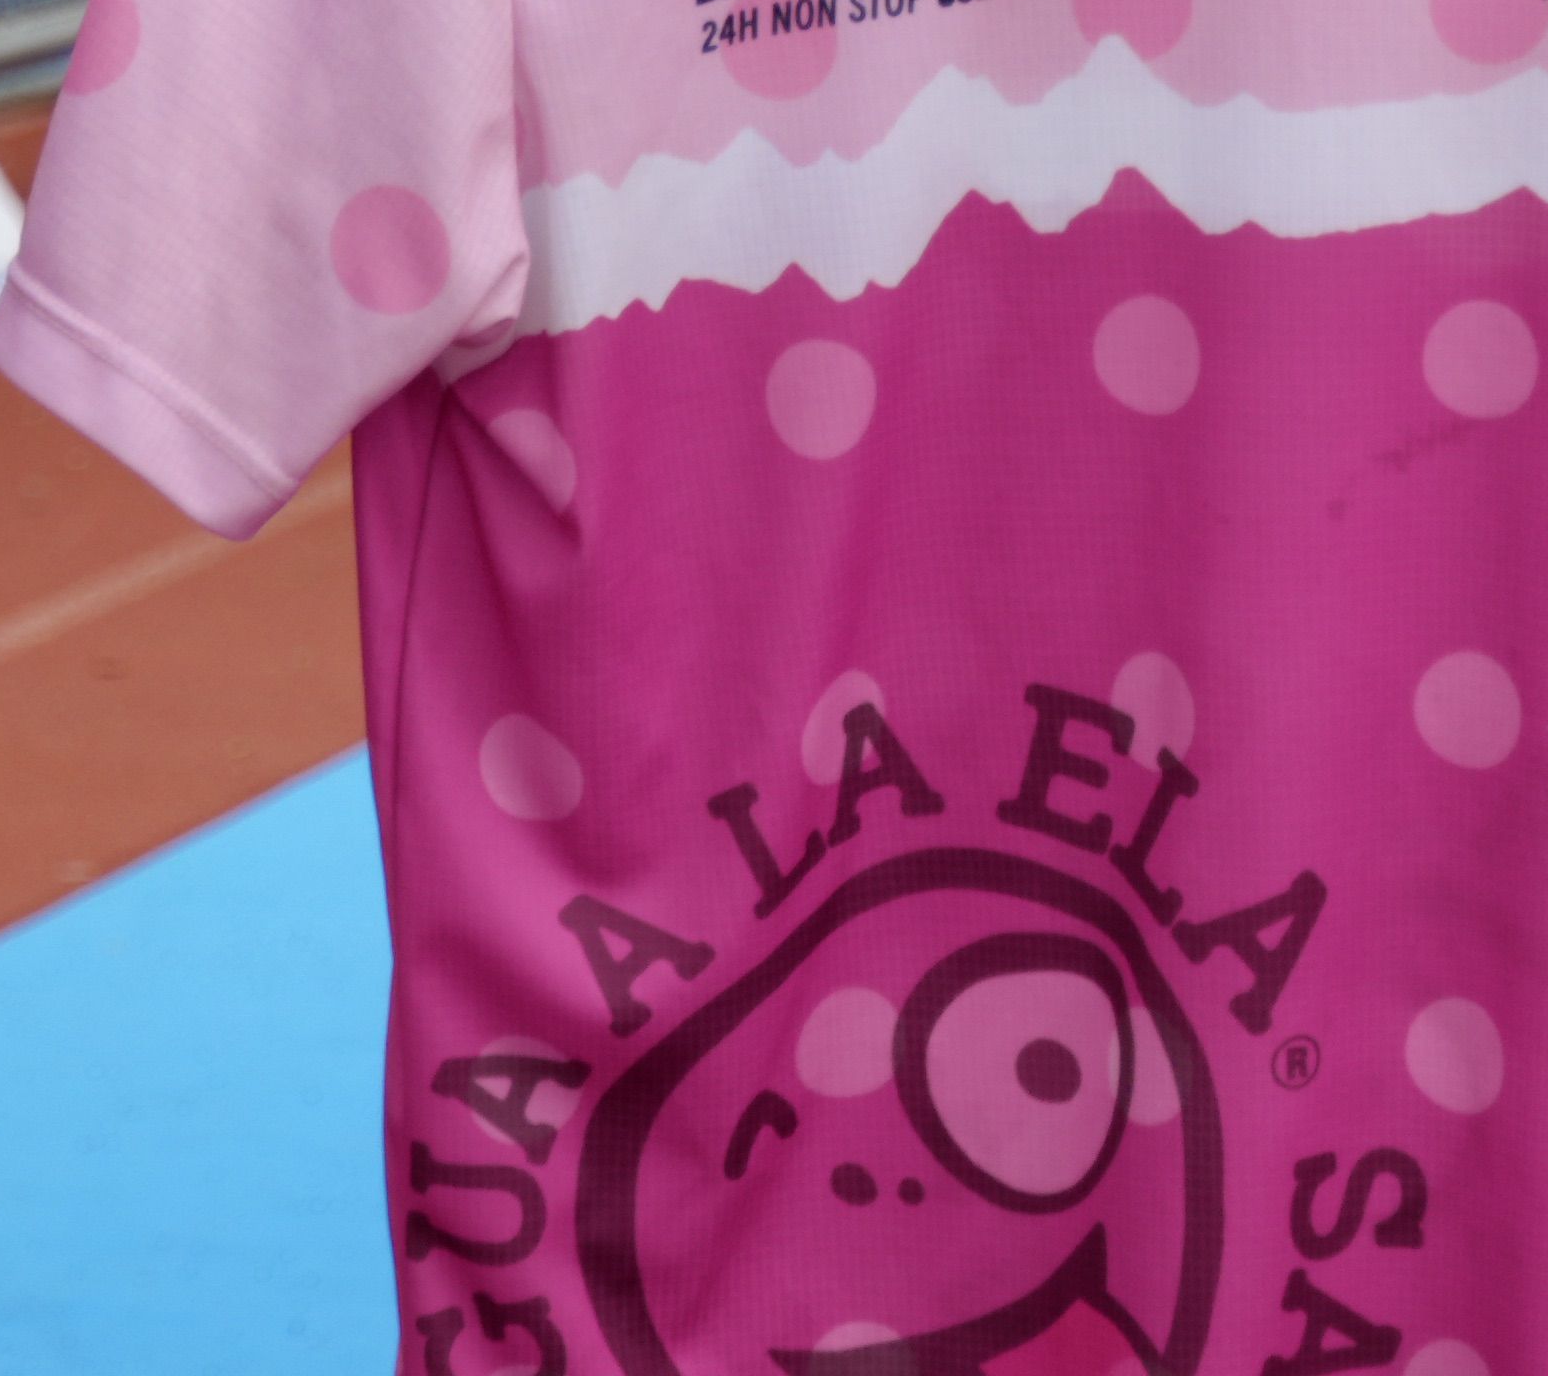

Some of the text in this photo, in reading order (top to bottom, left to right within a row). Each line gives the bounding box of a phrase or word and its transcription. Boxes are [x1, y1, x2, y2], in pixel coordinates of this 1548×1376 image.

[701, 8, 759, 53] 24H
[558, 893, 715, 1038] A
[706, 701, 945, 919] LA
[997, 683, 1328, 1036] ELA
